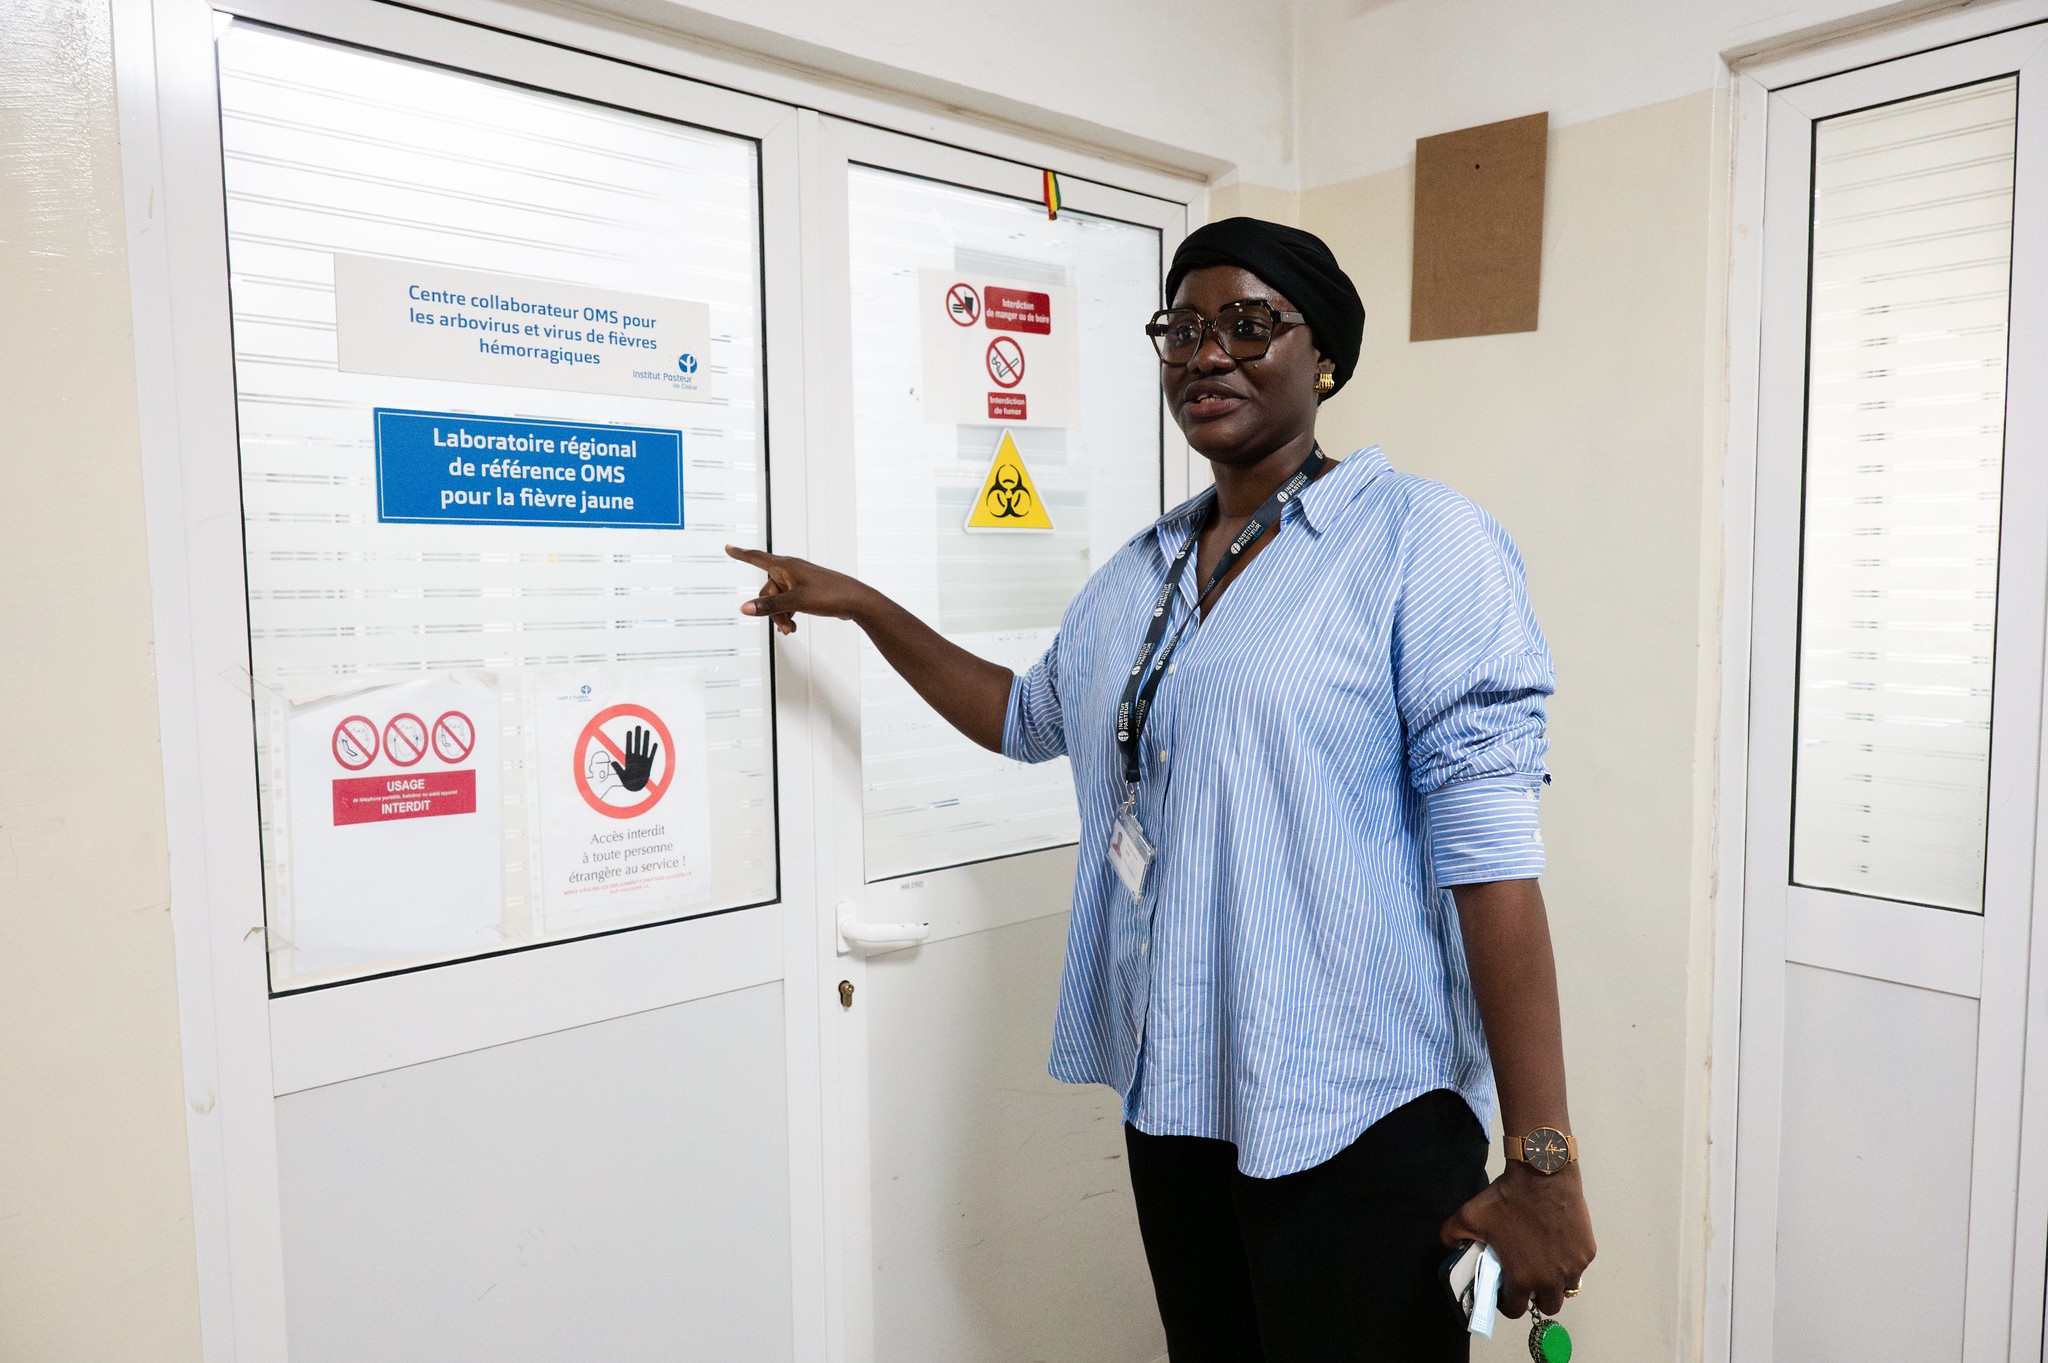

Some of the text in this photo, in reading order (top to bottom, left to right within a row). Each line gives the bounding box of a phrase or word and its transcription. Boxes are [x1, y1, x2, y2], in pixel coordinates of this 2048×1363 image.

[408, 285, 657, 330] Centre collaborateur OMS pour
[986, 308, 994, 318] de
[995, 310, 1018, 322] manger
[1018, 313, 1027, 321] ou
[1027, 312, 1034, 322] de
[1002, 298, 1034, 310] Interdiction
[409, 308, 657, 350] les arbovirus et virus de fièvres
[479, 338, 601, 366] hémorragiques
[632, 369, 692, 383] Institut Pasteur
[990, 396, 1025, 405] Interdiction
[994, 406, 1021, 415] de fumer
[433, 428, 638, 461] Laboratoire régional
[448, 456, 626, 484] de référence OMS
[1284, 471, 1304, 493] INSTITUT
[1288, 474, 1308, 496] PASTEUR
[440, 486, 635, 513] pour la fièvre jaune
[1237, 519, 1257, 543] INSTITUT
[1240, 523, 1262, 547] PASTEUR
[386, 779, 425, 792] USAGE
[381, 800, 431, 815] INTERDIT
[590, 824, 665, 845] Accès interdit
[582, 842, 674, 864] à toute personne
[568, 866, 622, 883] étrangère
[625, 865, 638, 875] au
[641, 858, 679, 873] service
[682, 855, 686, 866] !
